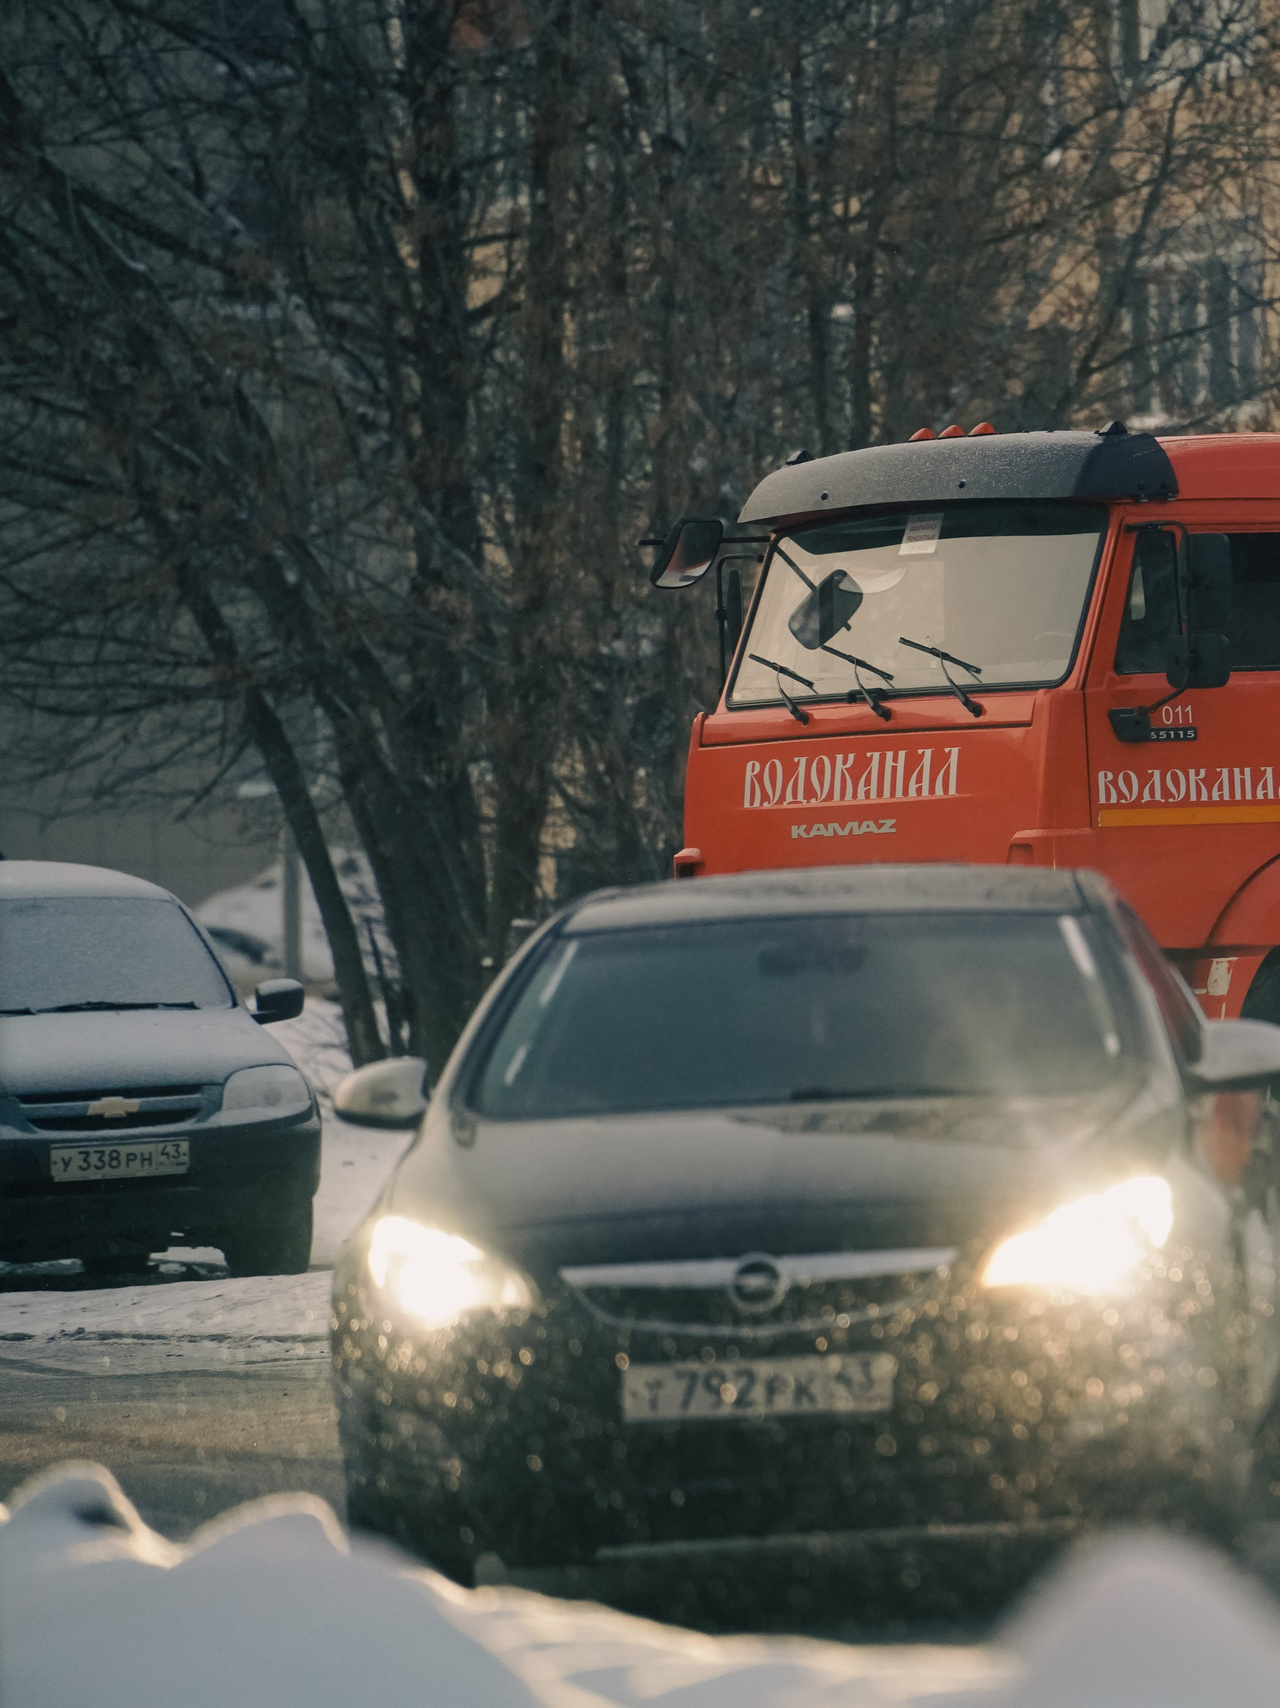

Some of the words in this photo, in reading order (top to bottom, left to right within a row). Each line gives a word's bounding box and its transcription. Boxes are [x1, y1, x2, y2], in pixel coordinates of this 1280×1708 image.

[1162, 705, 1193, 724] 011
[744, 747, 961, 808] ВОДОКАНАЛ
[791, 819, 896, 839] KAMAZ
